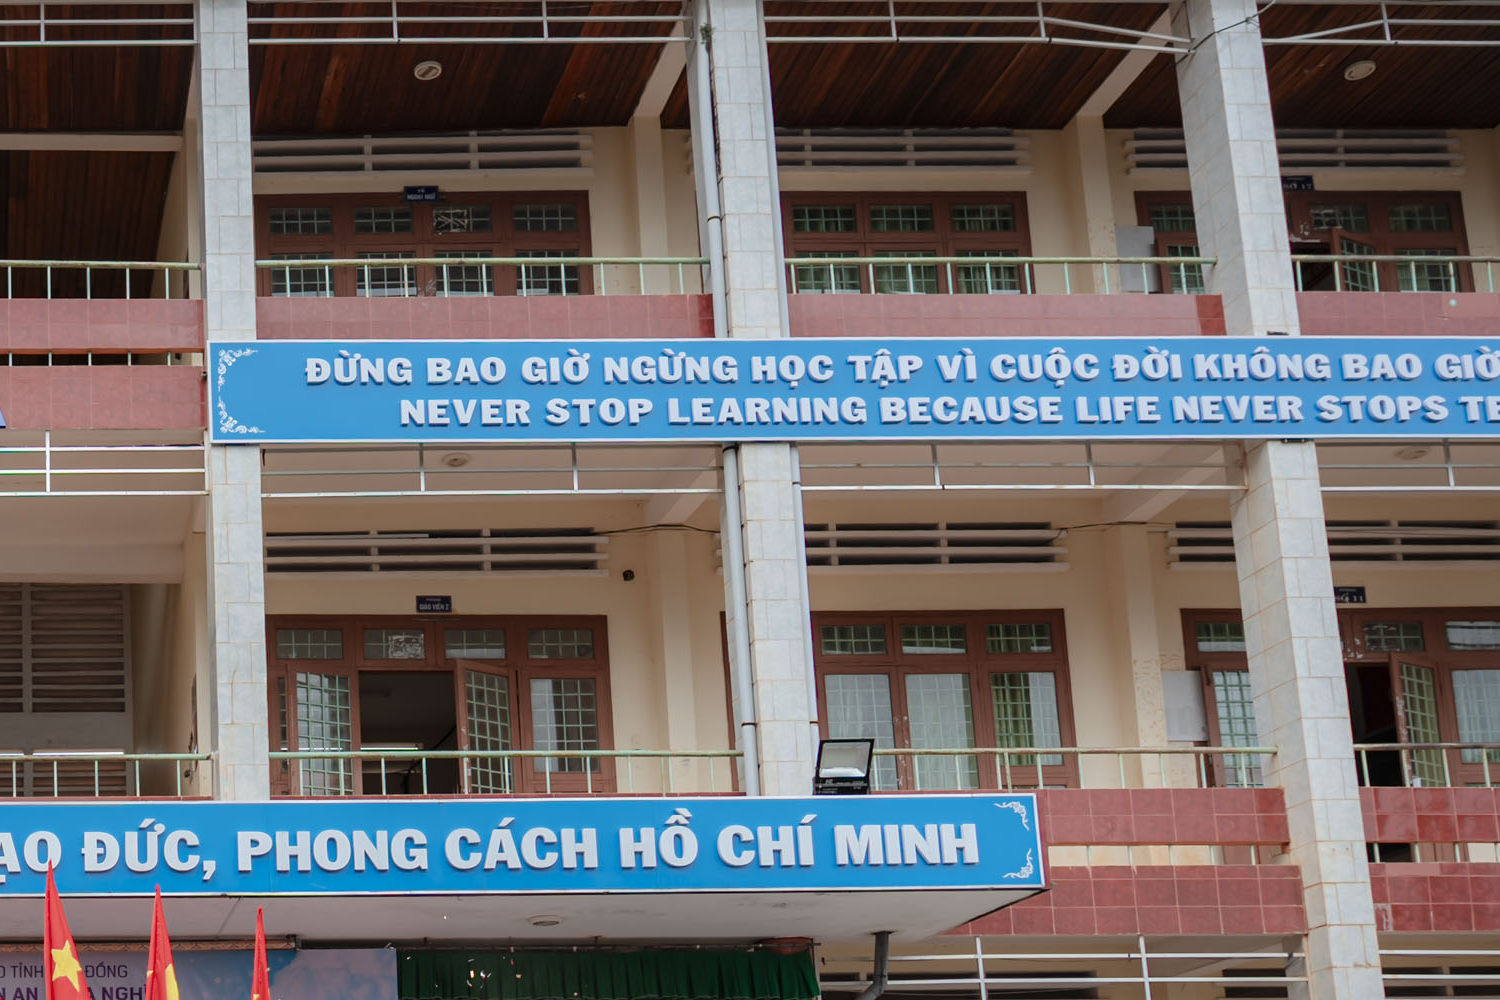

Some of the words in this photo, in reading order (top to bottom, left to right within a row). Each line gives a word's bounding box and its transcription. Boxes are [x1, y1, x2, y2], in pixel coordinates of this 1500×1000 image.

[305, 350, 413, 385] ĐỪNG
[428, 357, 506, 383] BAO
[522, 349, 590, 383] GIỜ
[604, 349, 739, 383] NGỪNG
[752, 355, 834, 389] HỌC
[848, 348, 924, 388] TẬP
[937, 348, 978, 381] VÌ
[990, 347, 1100, 388] CUỘC
[1112, 346, 1182, 381] ĐỜI
[1194, 346, 1331, 381] KHÔNG
[1343, 354, 1422, 380] BAO
[1433, 345, 1500, 380] GIỜ
[400, 399, 531, 426] NEVER
[546, 398, 653, 425] STOP
[668, 397, 868, 425] LEARNING
[882, 398, 1064, 424] BECAUSE
[1077, 398, 1161, 423] LIFE
[1174, 397, 1303, 422] NEVER
[1317, 397, 1450, 422] STOPS
[81, 819, 216, 880] ĐỨC,
[237, 829, 429, 871] PHONG
[445, 818, 599, 870] CÁCH
[618, 808, 699, 869] HỒ
[717, 815, 817, 868] CHÍ
[834, 824, 979, 867] MINH
[11, 962, 44, 978] TỈNH
[13, 987, 38, 1000] AN
